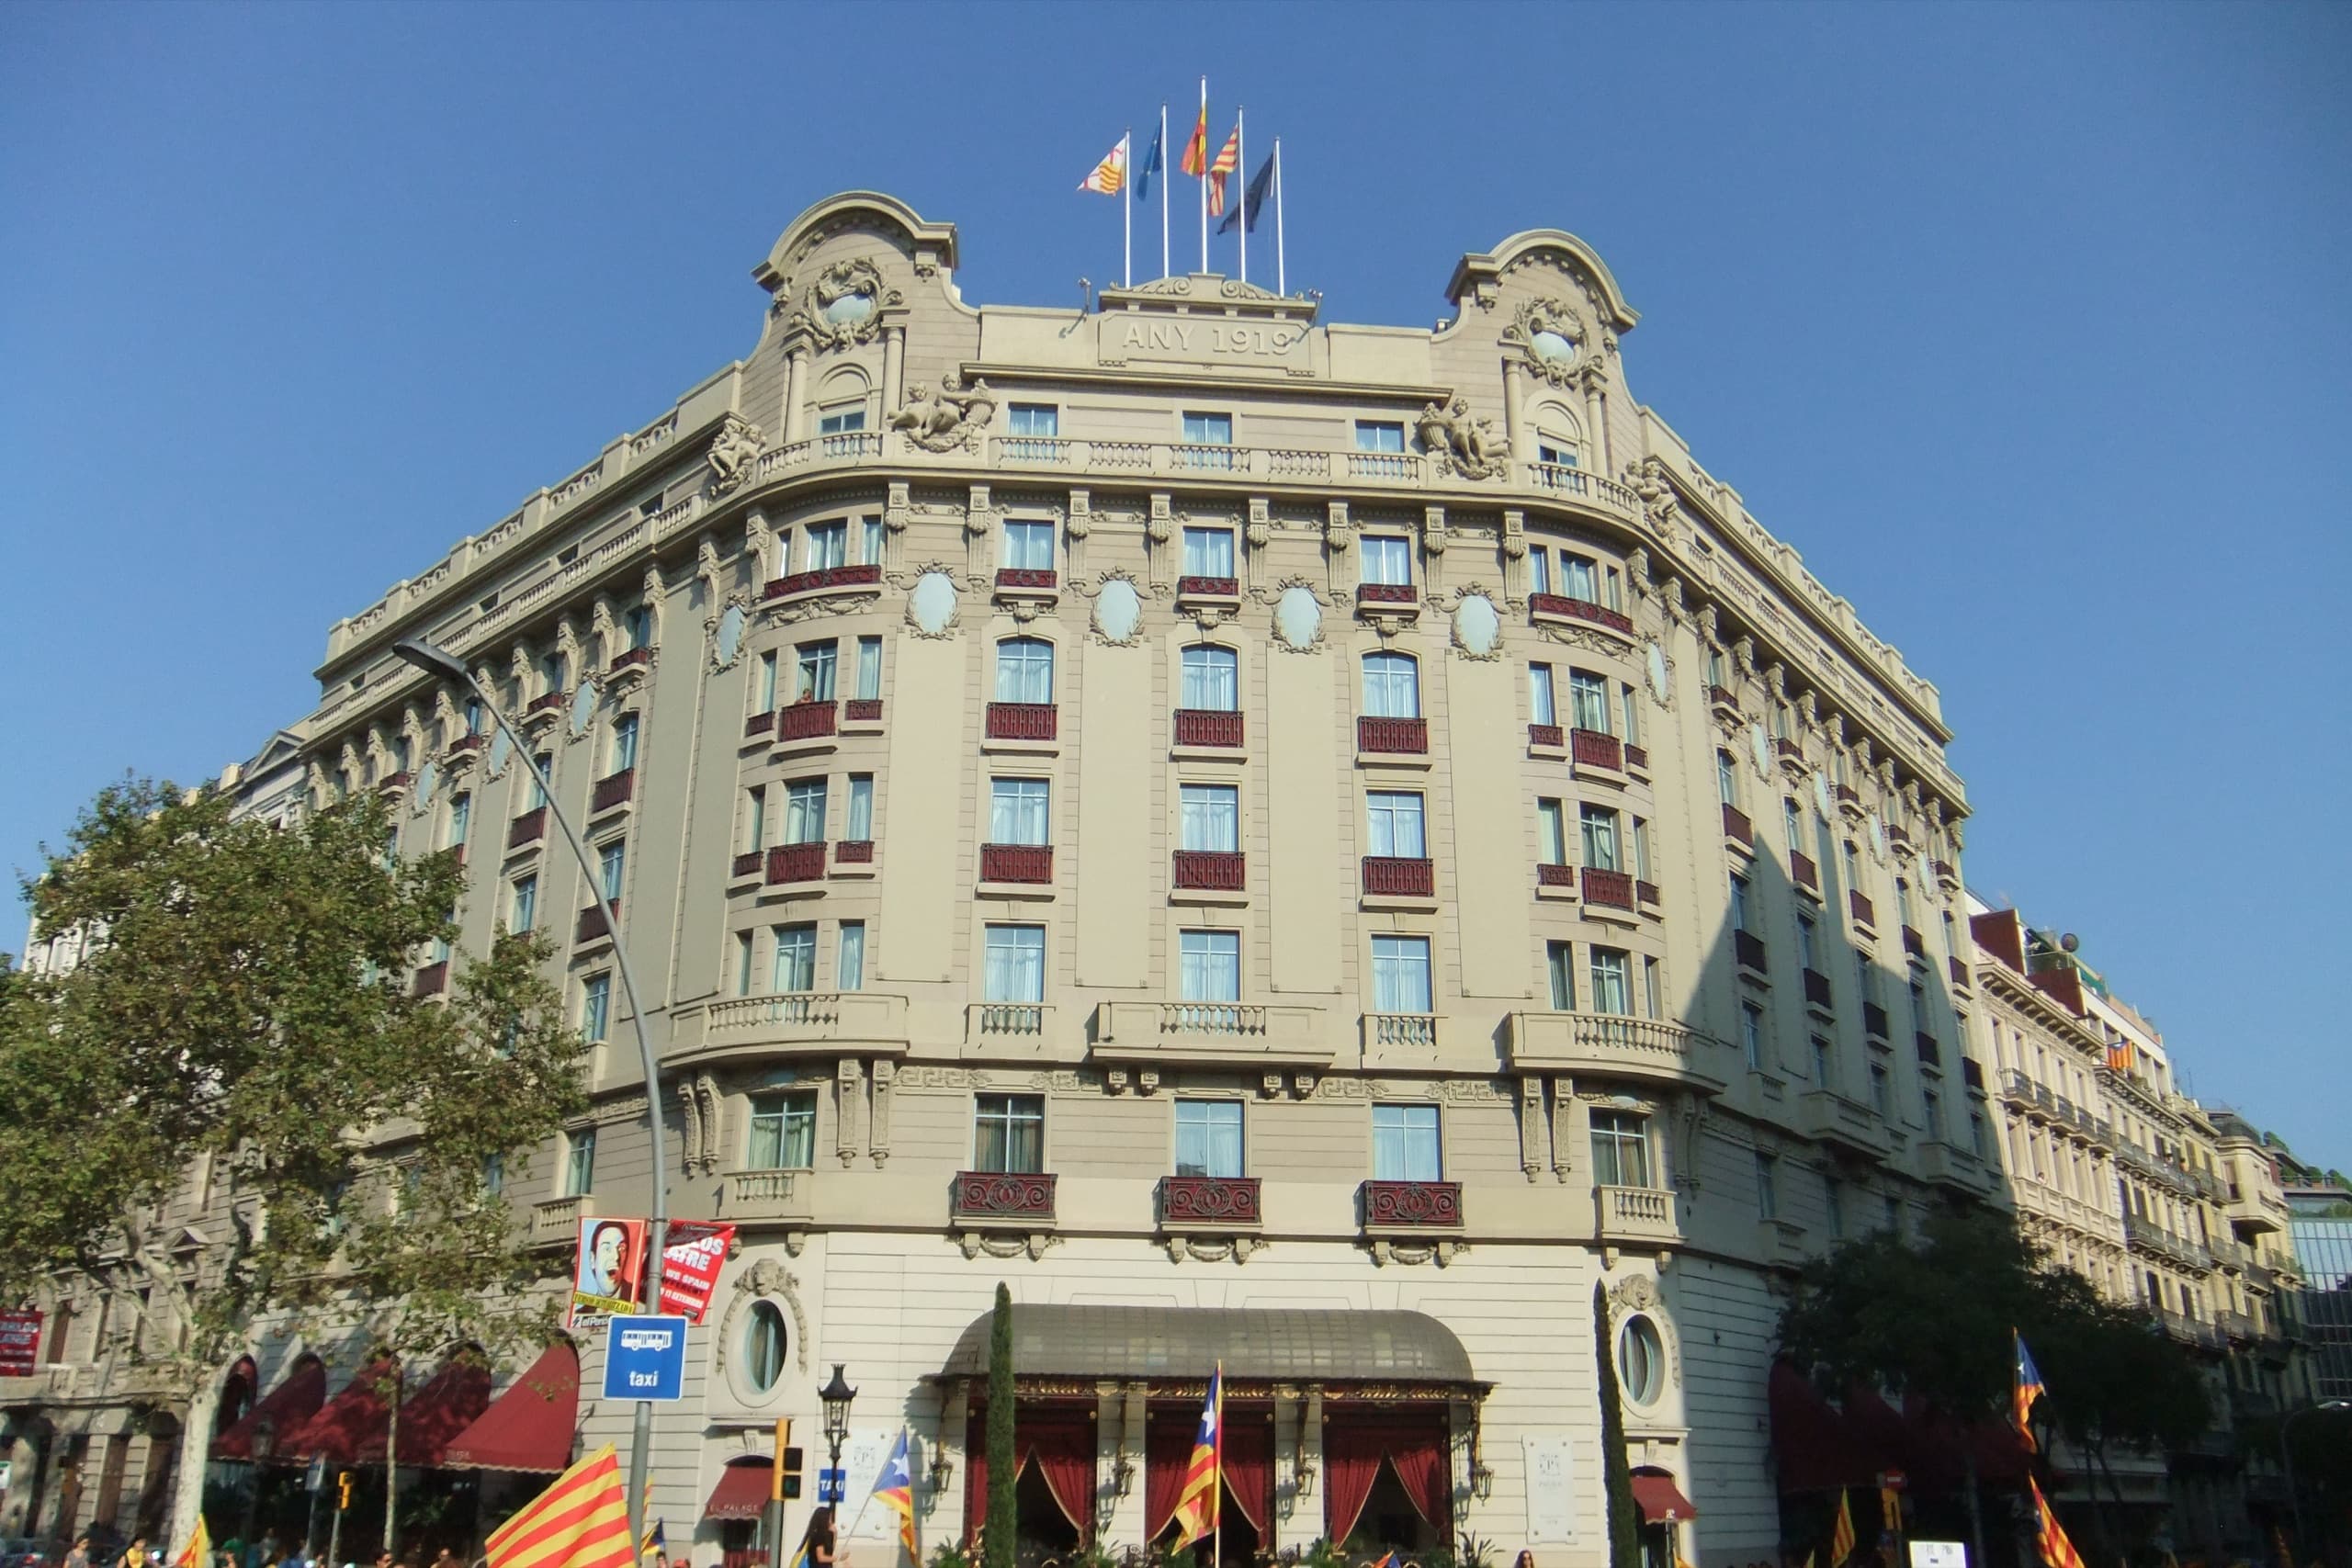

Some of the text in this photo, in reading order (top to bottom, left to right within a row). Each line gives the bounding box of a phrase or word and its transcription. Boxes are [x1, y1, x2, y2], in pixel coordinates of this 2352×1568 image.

[1122, 322, 1295, 355] ANY 1919
[682, 1273, 710, 1291] SPAIN
[629, 1371, 658, 1387] taxi
[724, 1503, 760, 1513] PALACE
